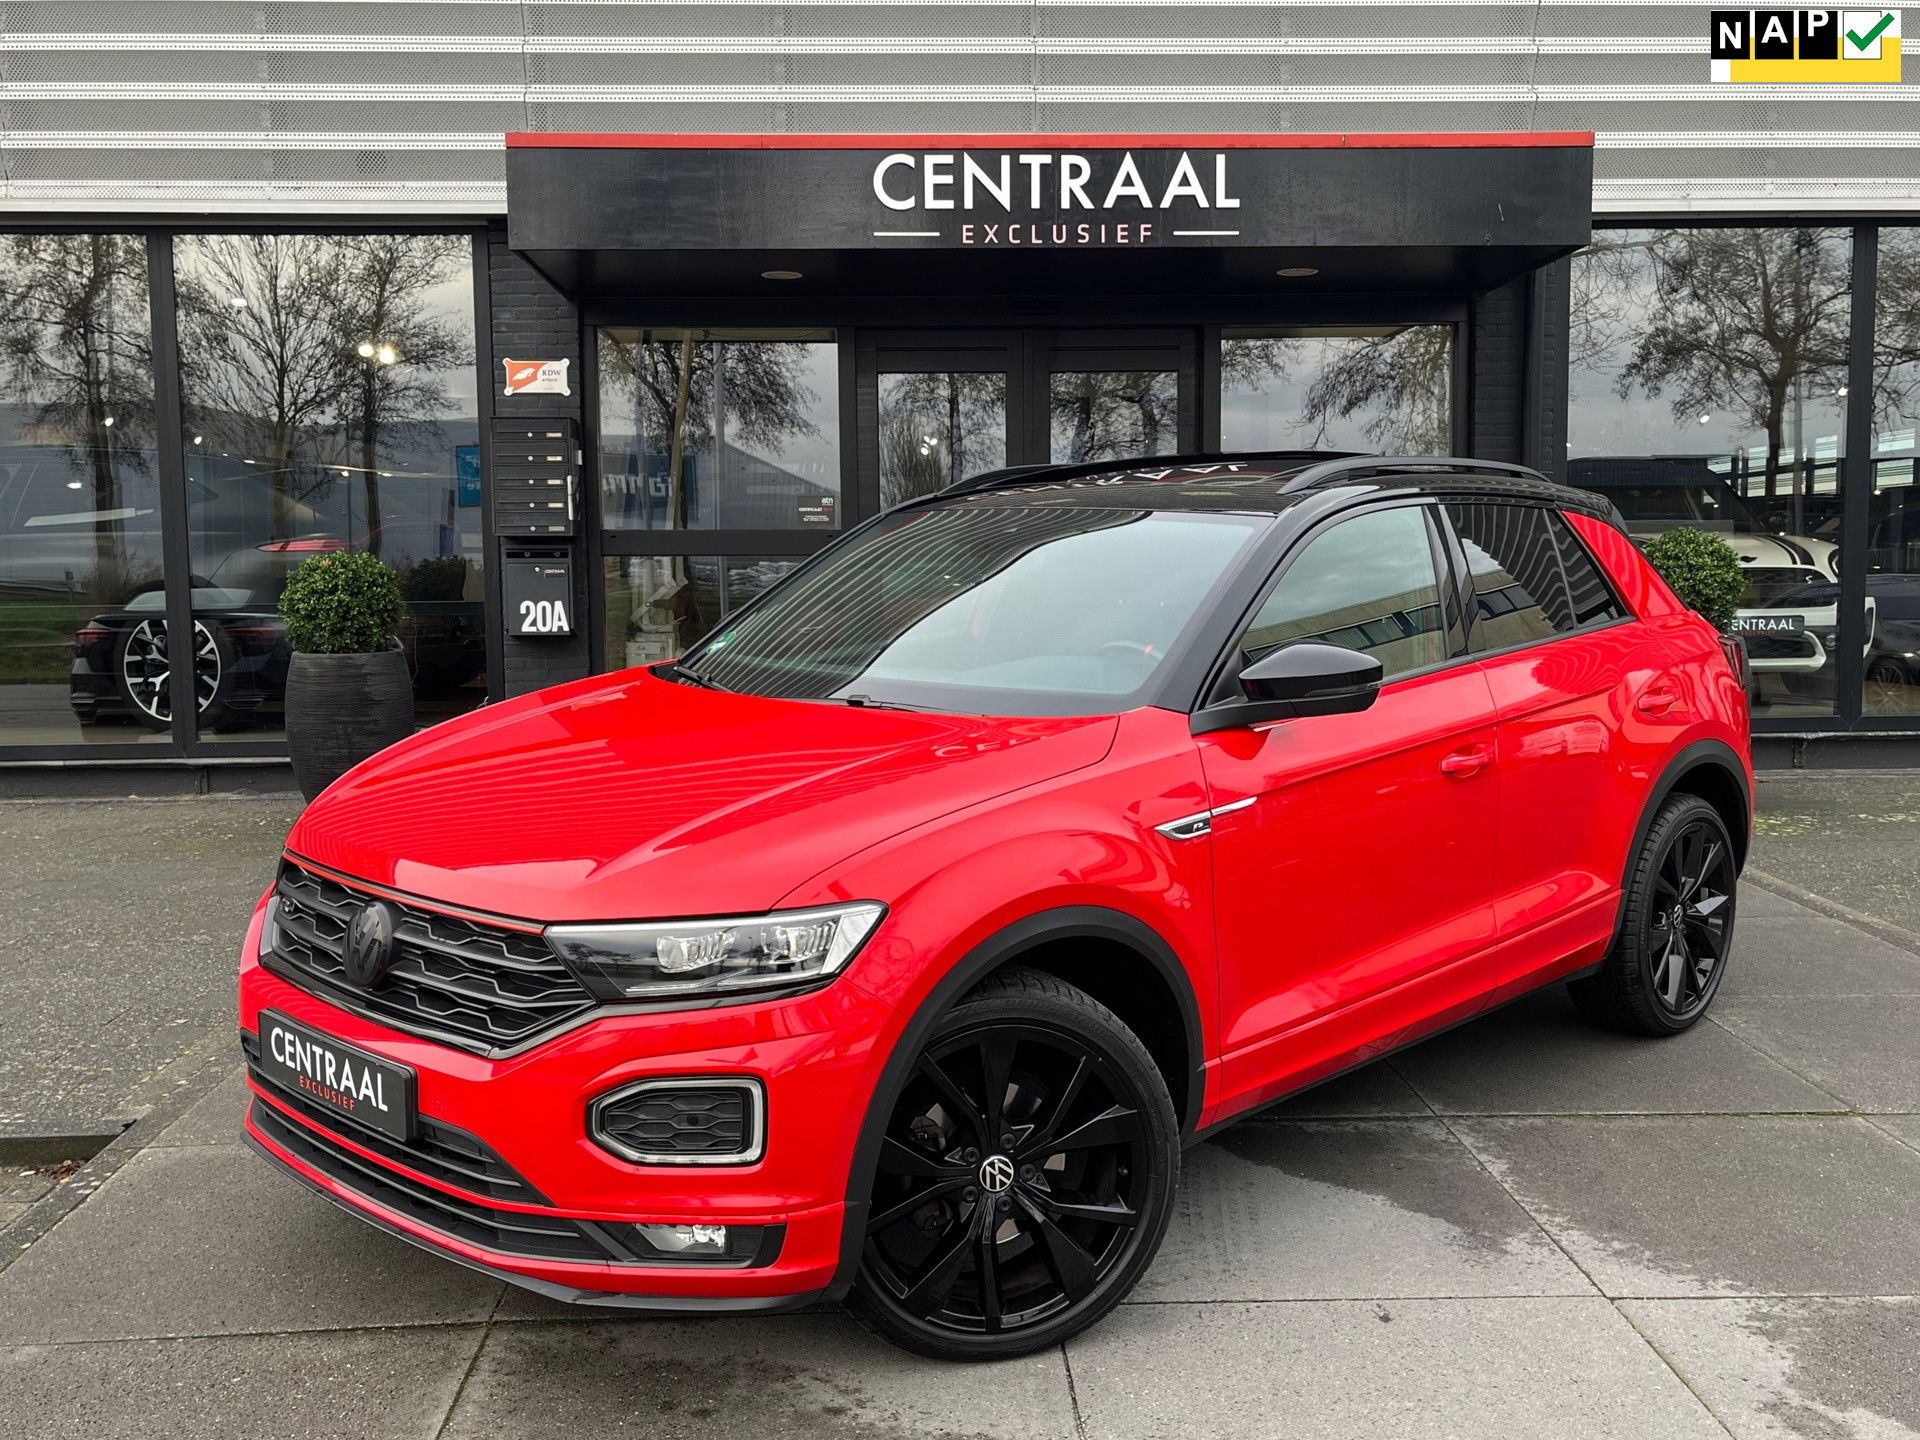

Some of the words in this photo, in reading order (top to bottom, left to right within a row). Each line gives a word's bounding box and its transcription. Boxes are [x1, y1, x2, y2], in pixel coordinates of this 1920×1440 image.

[873, 151, 1241, 211] CENTRAAL
[962, 223, 1152, 244] EXCLUSIEF
[519, 600, 570, 633] 20A
[270, 1027, 389, 1112] CENTRAAL
[298, 1075, 357, 1112] EXCLUSIEF
